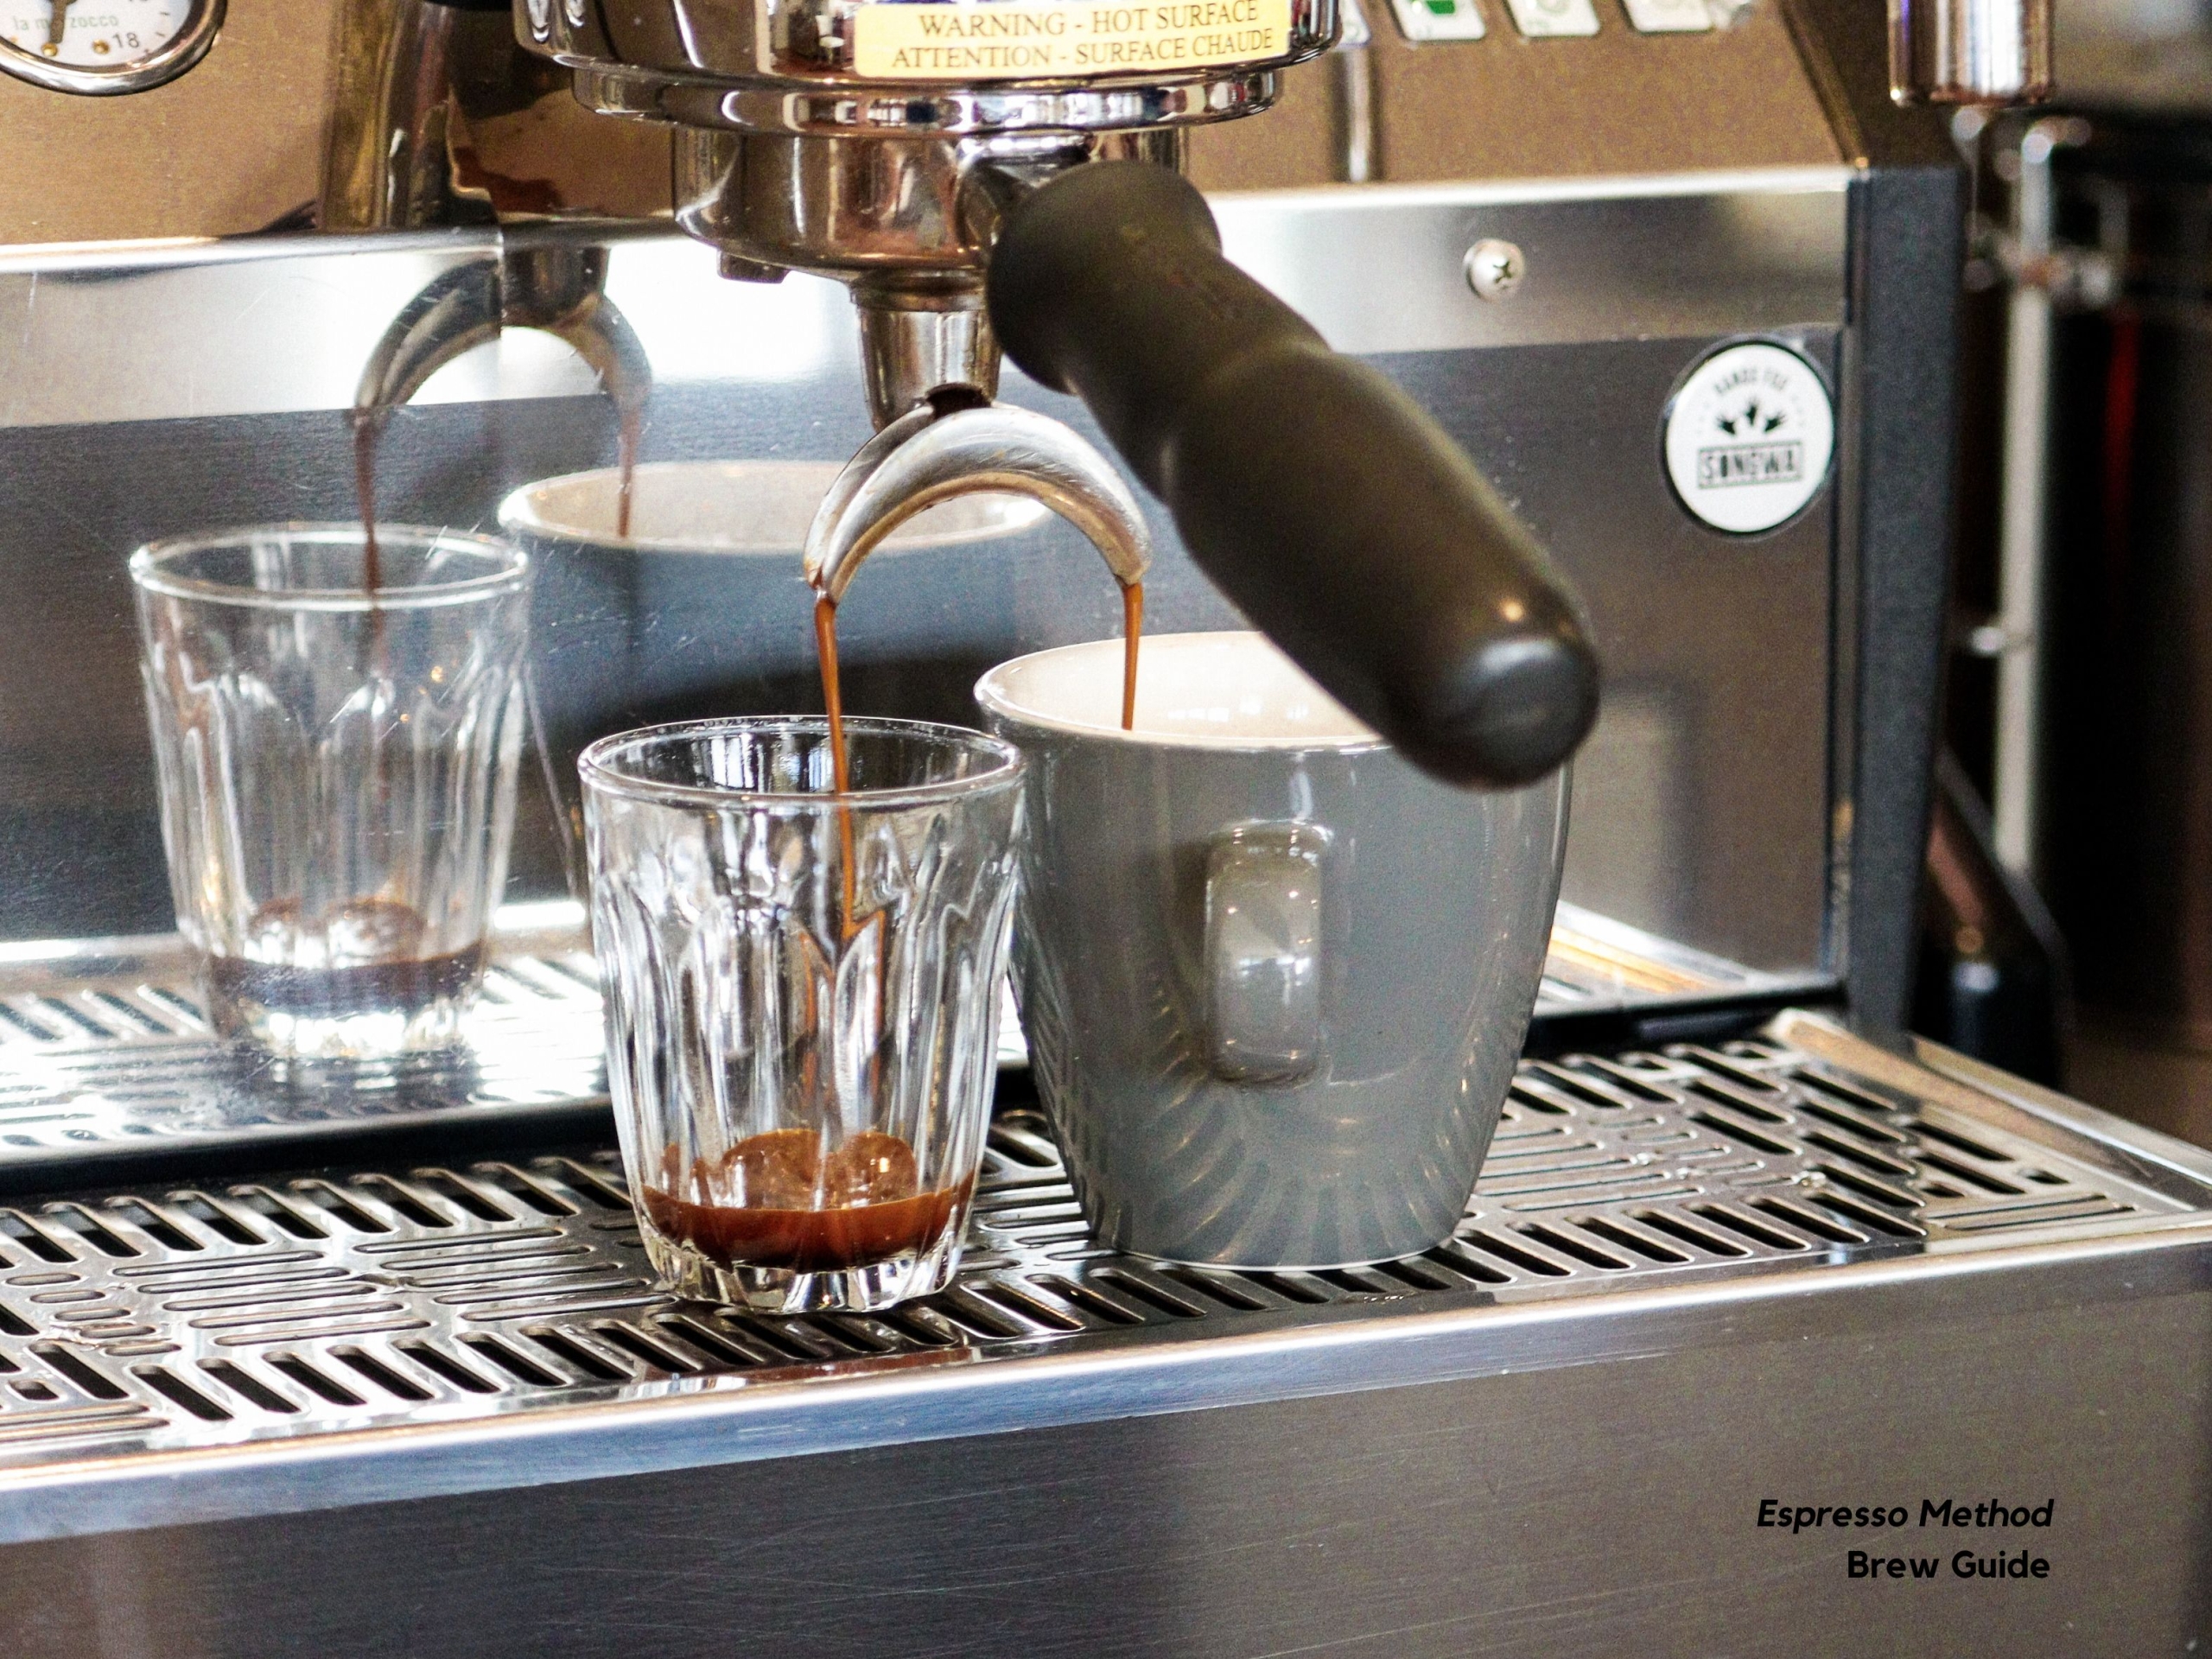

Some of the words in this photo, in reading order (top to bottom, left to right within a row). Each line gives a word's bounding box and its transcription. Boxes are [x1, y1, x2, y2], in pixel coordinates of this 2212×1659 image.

[12, 16, 29, 30] la
[35, 15, 119, 30] mzocco
[918, 13, 1065, 37] WARNING
[1092, 9, 1148, 34] HOT
[1155, 0, 1258, 29] SURFACE
[111, 31, 140, 48] 18
[892, 45, 1052, 68] ATTENTION
[1075, 37, 1185, 65] SURFACE
[1192, 28, 1273, 57] CHAUDE
